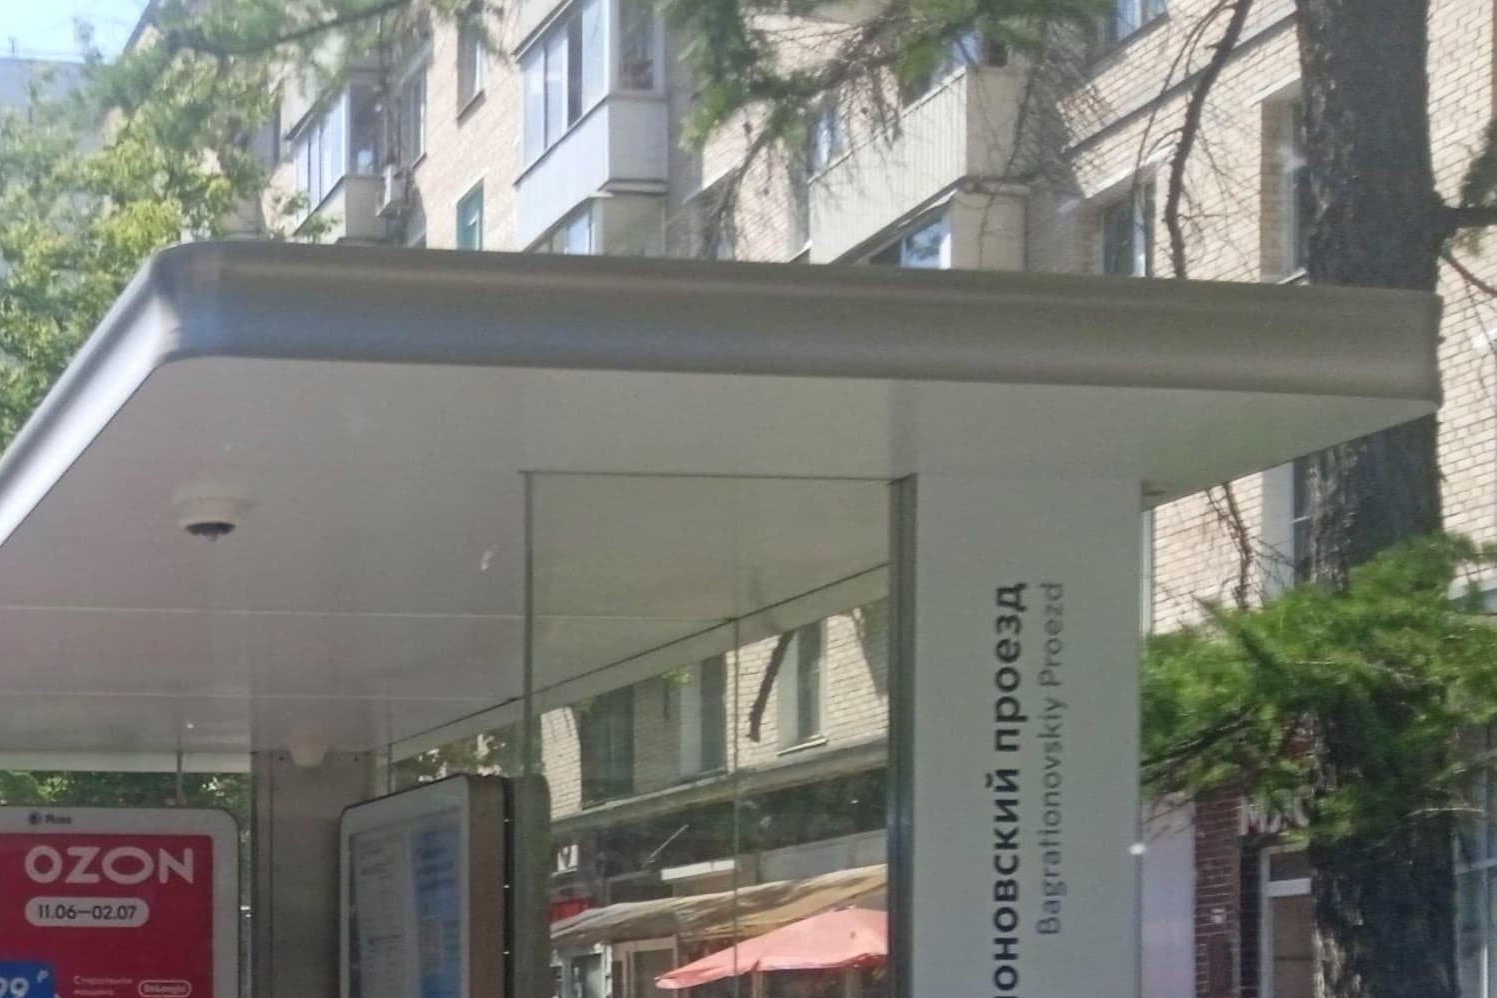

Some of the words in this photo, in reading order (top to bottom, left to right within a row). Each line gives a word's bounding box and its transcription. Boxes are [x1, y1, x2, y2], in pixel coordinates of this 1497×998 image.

[994, 581, 1029, 752] проезд
[1036, 582, 1064, 687] Proezd
[24, 845, 194, 885] OZON
[1036, 696, 1069, 935] Bagrationovskiy
